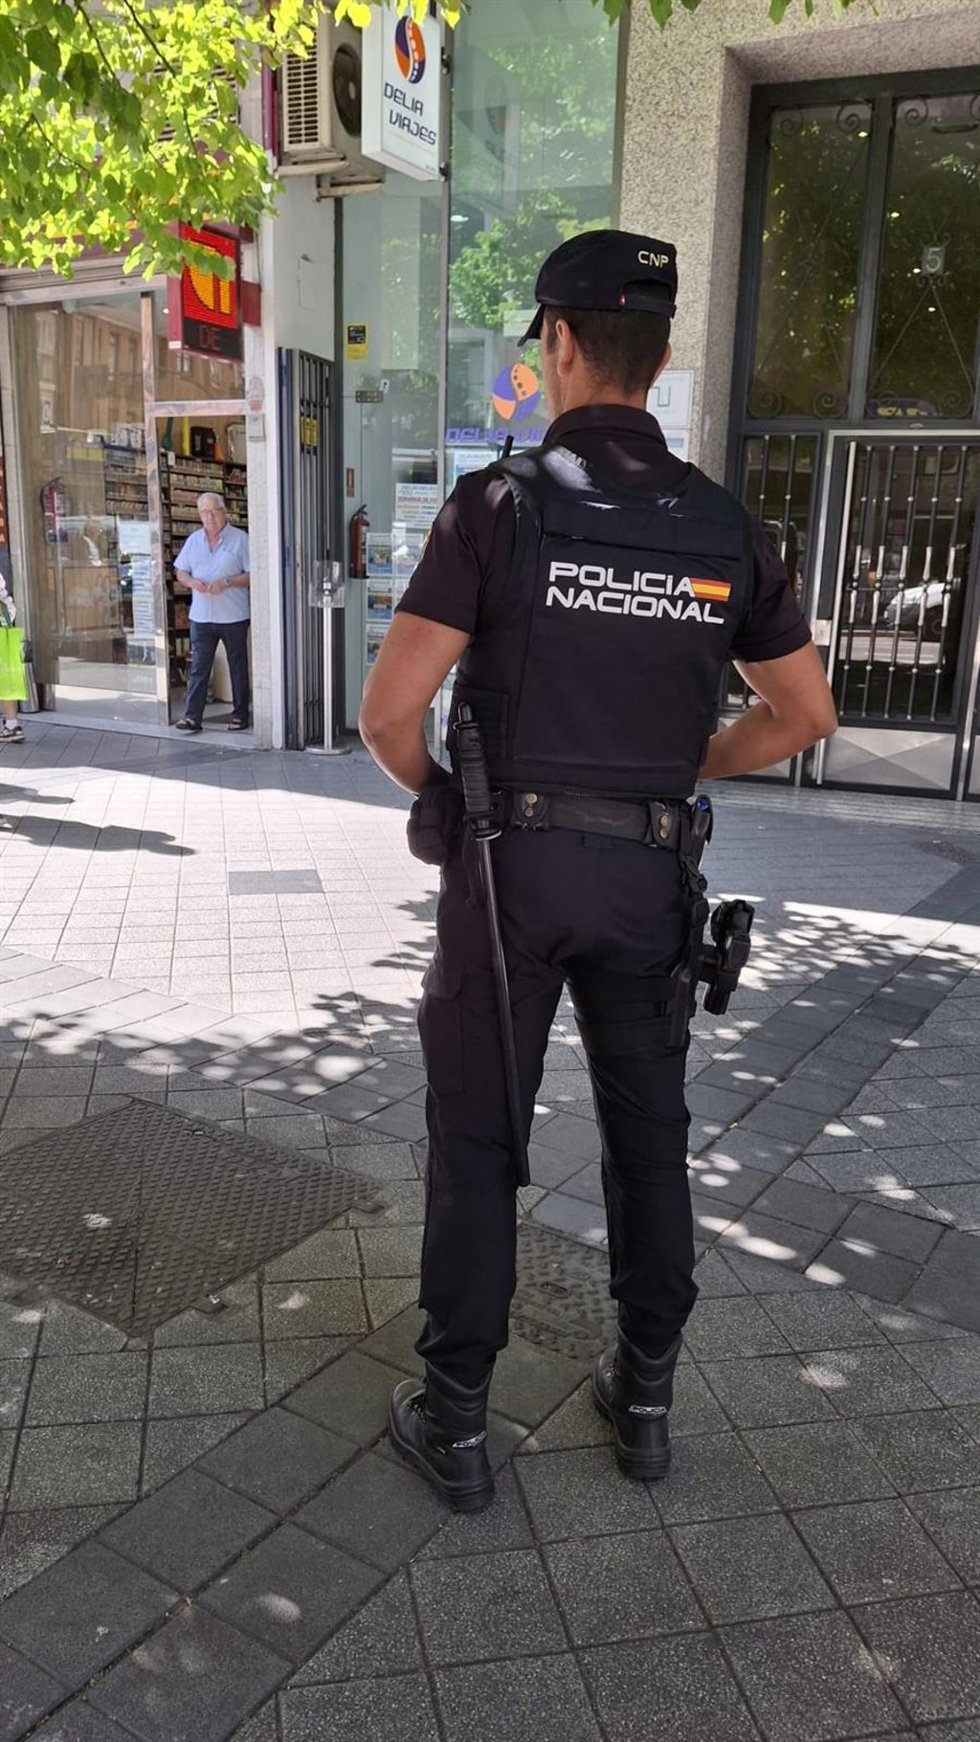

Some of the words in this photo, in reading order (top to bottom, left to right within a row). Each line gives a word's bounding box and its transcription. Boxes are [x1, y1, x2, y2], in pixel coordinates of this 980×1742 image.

[384, 82, 424, 117] DELIA
[389, 109, 437, 146] VIAJES
[638, 250, 670, 268] CNP
[926, 247, 941, 272] 5
[546, 586, 725, 625] NACIONAL
